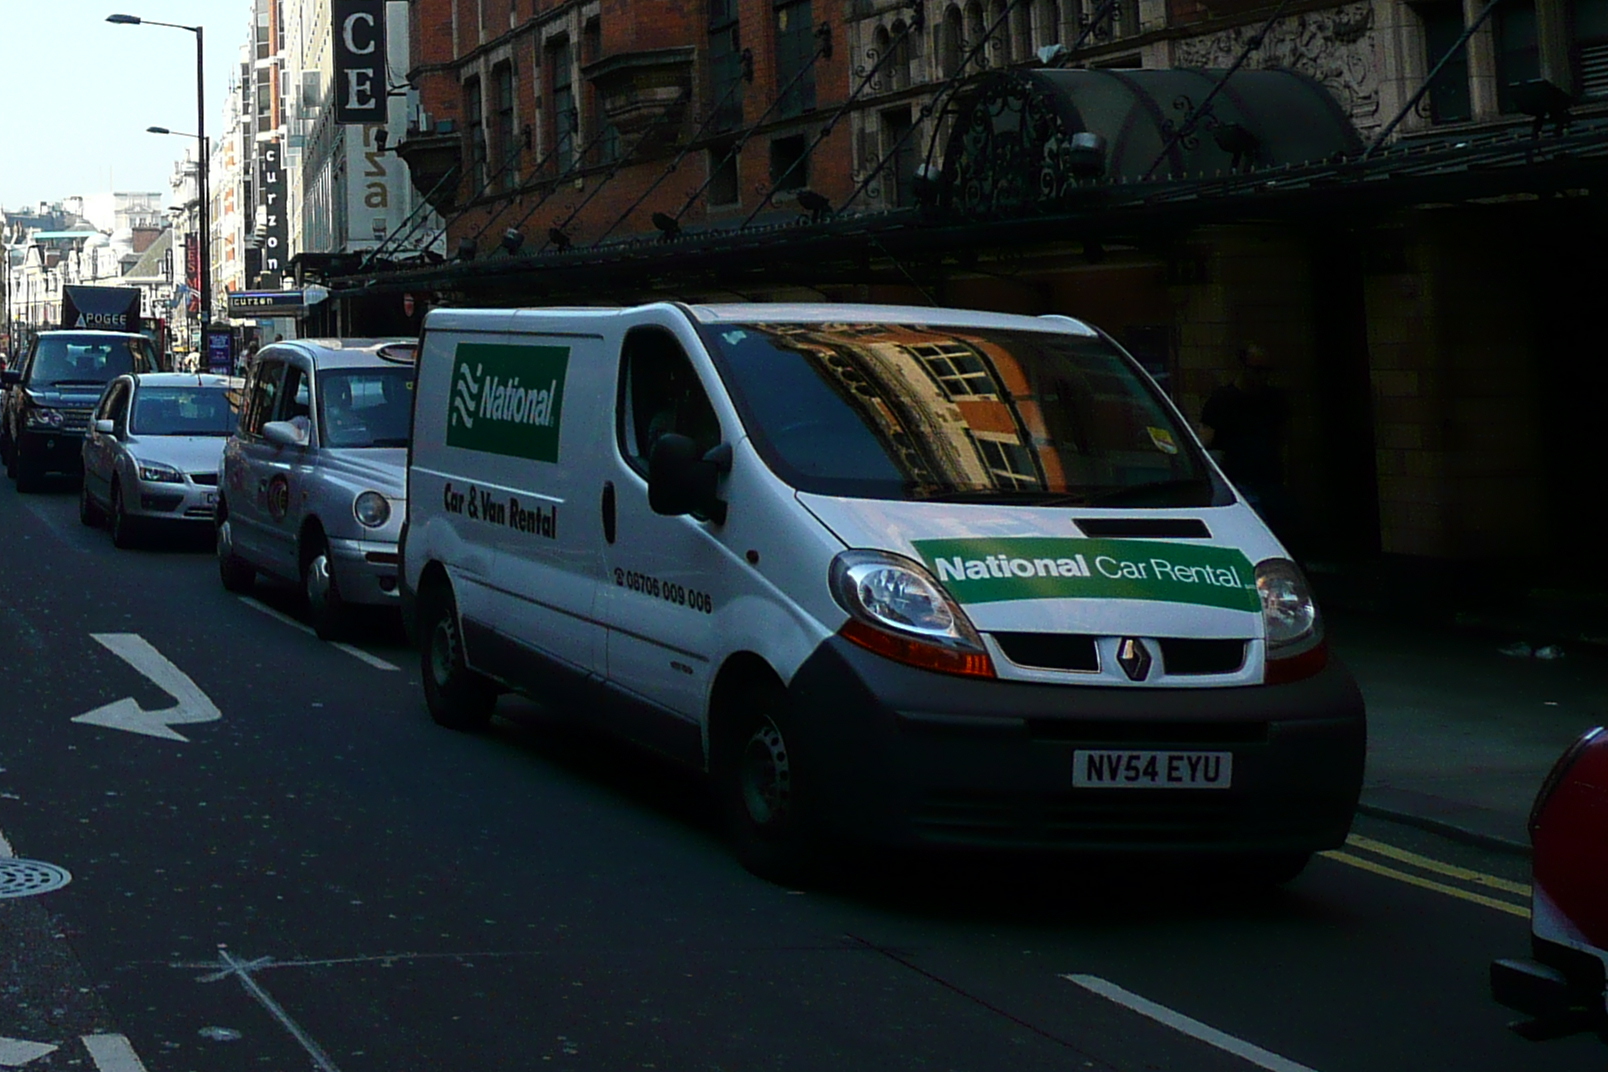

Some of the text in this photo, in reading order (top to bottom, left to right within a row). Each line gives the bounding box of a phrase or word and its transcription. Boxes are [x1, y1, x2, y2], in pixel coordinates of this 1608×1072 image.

[265, 148, 279, 271] curzon
[233, 296, 274, 306] curzon
[479, 375, 556, 427] National
[444, 482, 556, 540] Car & Van Rental
[626, 570, 712, 614] 08706 009 006
[933, 553, 1242, 588] National Car Rental
[1086, 754, 1221, 783] NV54 EYU
